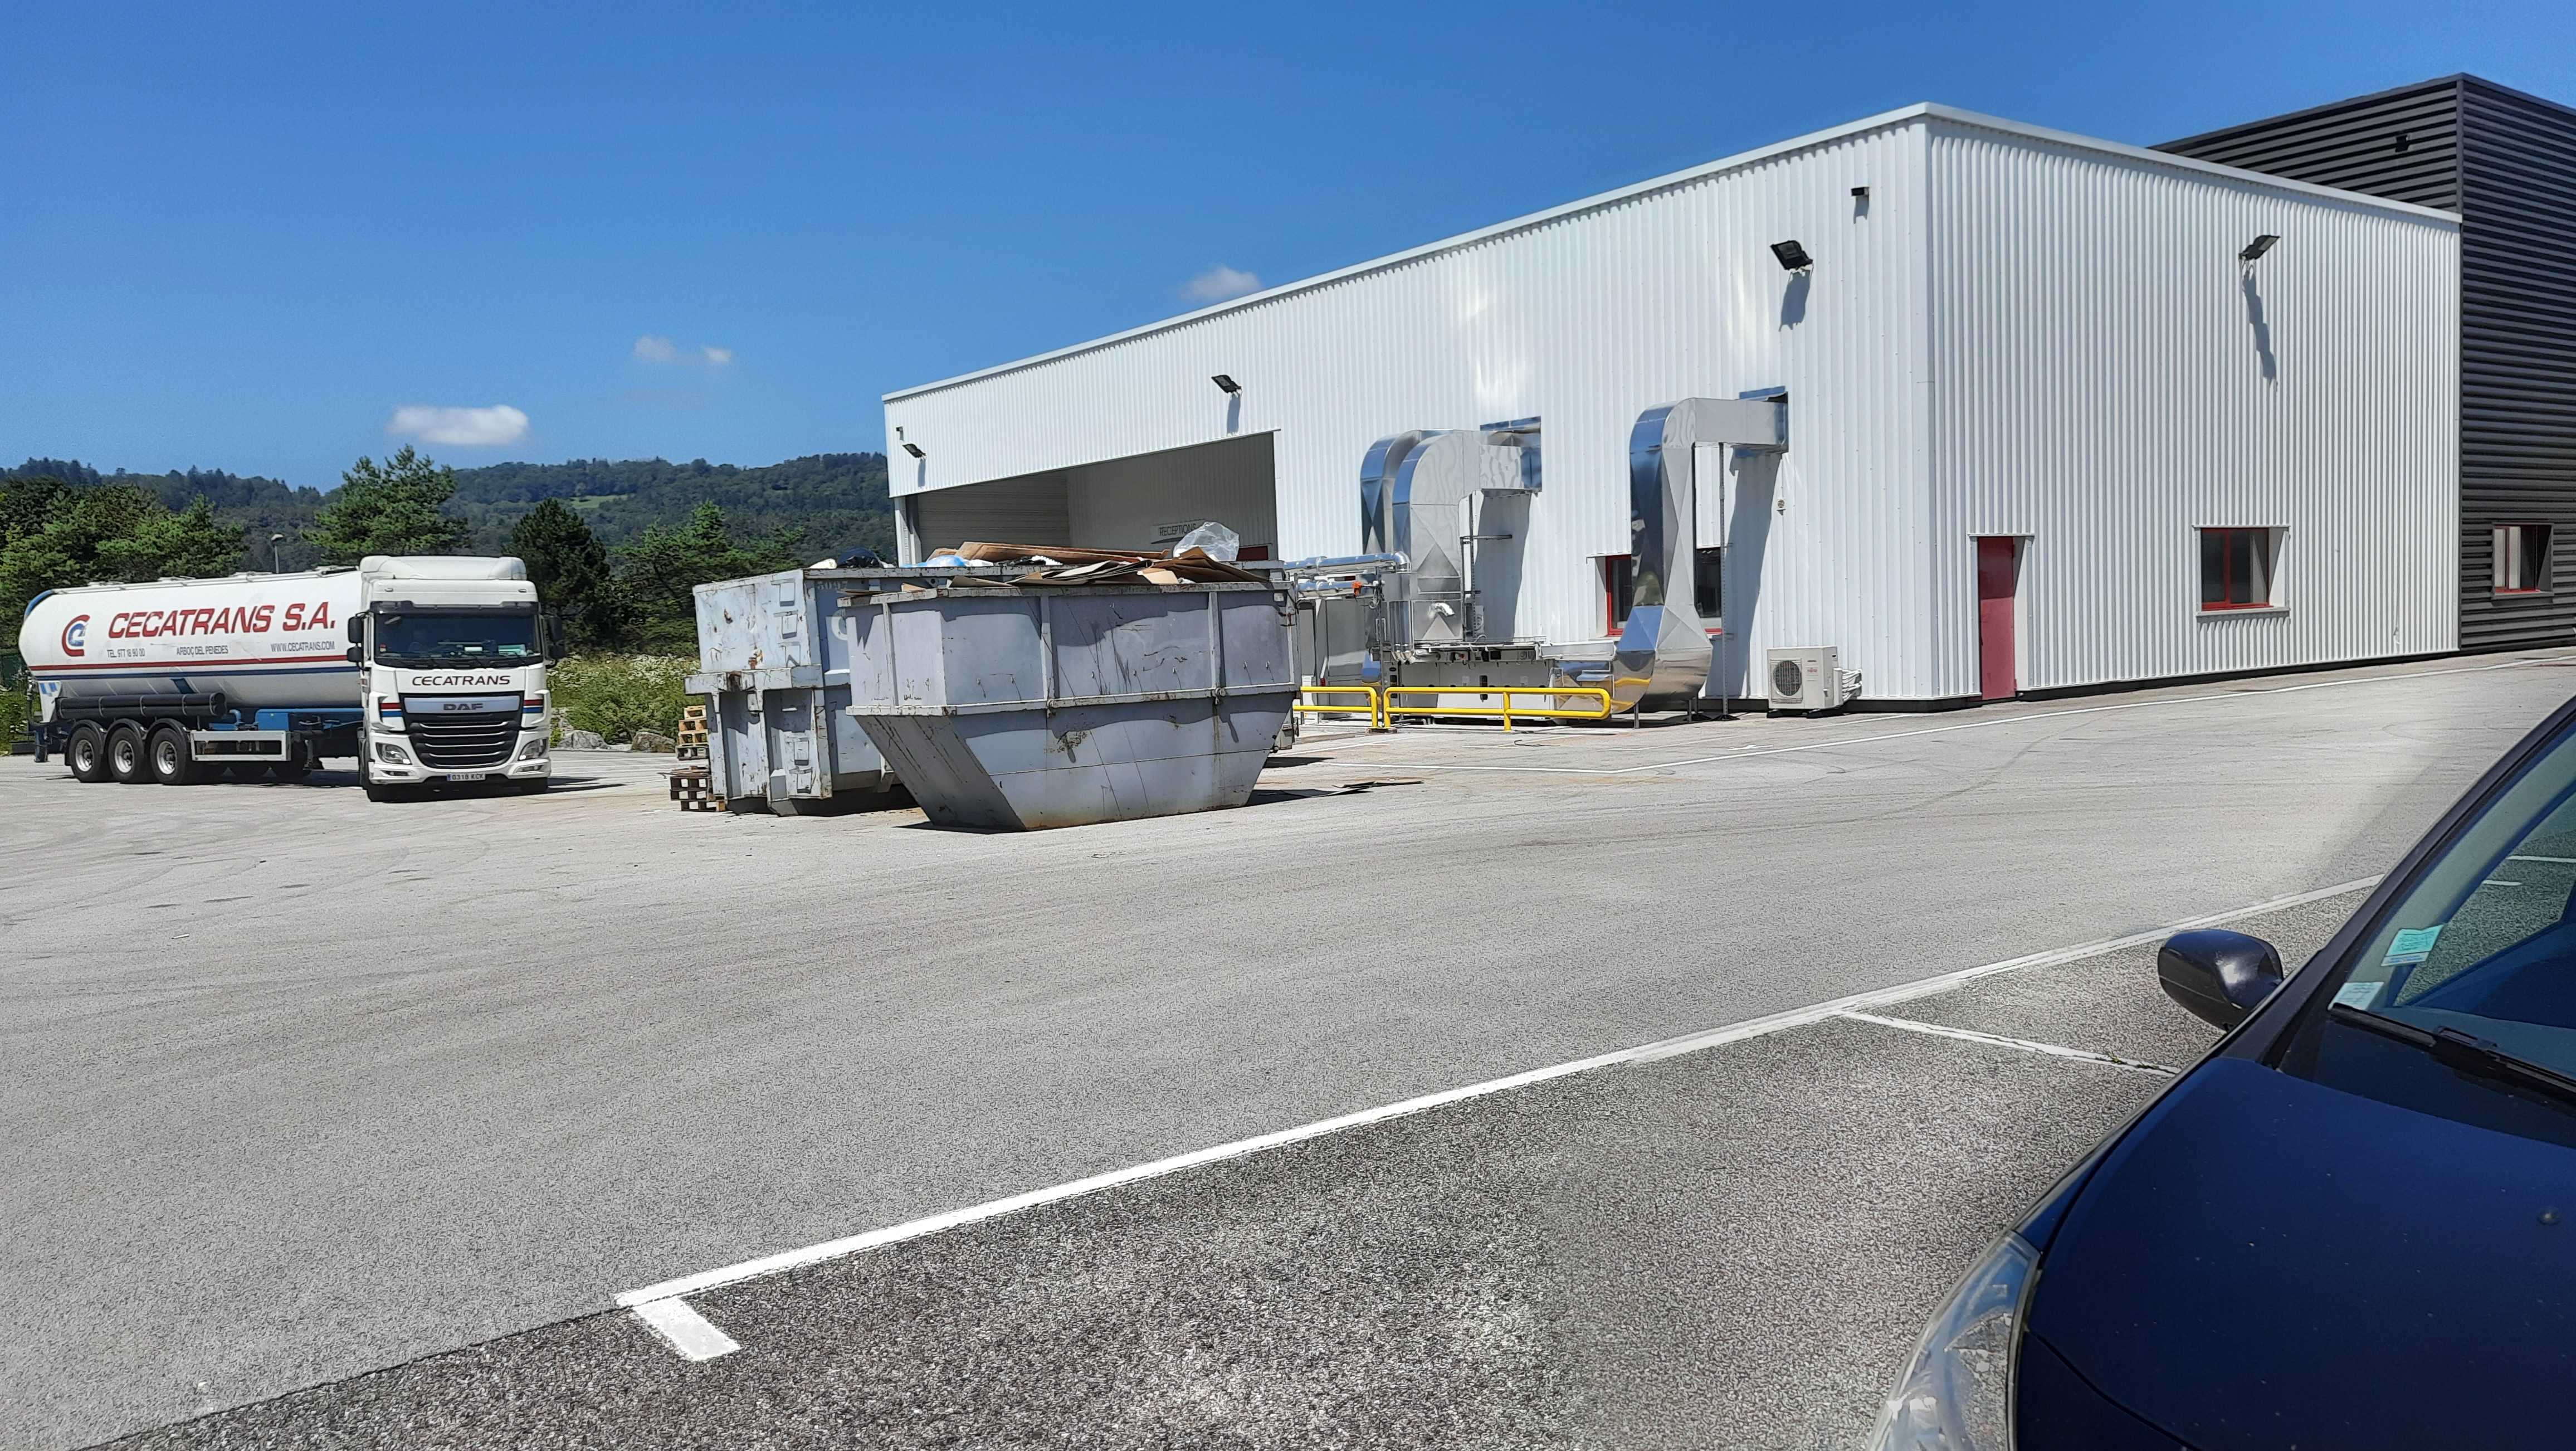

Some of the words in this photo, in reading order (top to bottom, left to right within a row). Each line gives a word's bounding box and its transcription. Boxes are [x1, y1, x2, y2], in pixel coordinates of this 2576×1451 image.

[108, 605, 275, 639] CECATRANS
[282, 601, 336, 631] S.A.
[195, 646, 205, 655] DEL
[271, 640, 335, 652] WWW.CECATRANS.COM
[412, 675, 511, 686] CECATRANS
[443, 703, 484, 711] DAF
